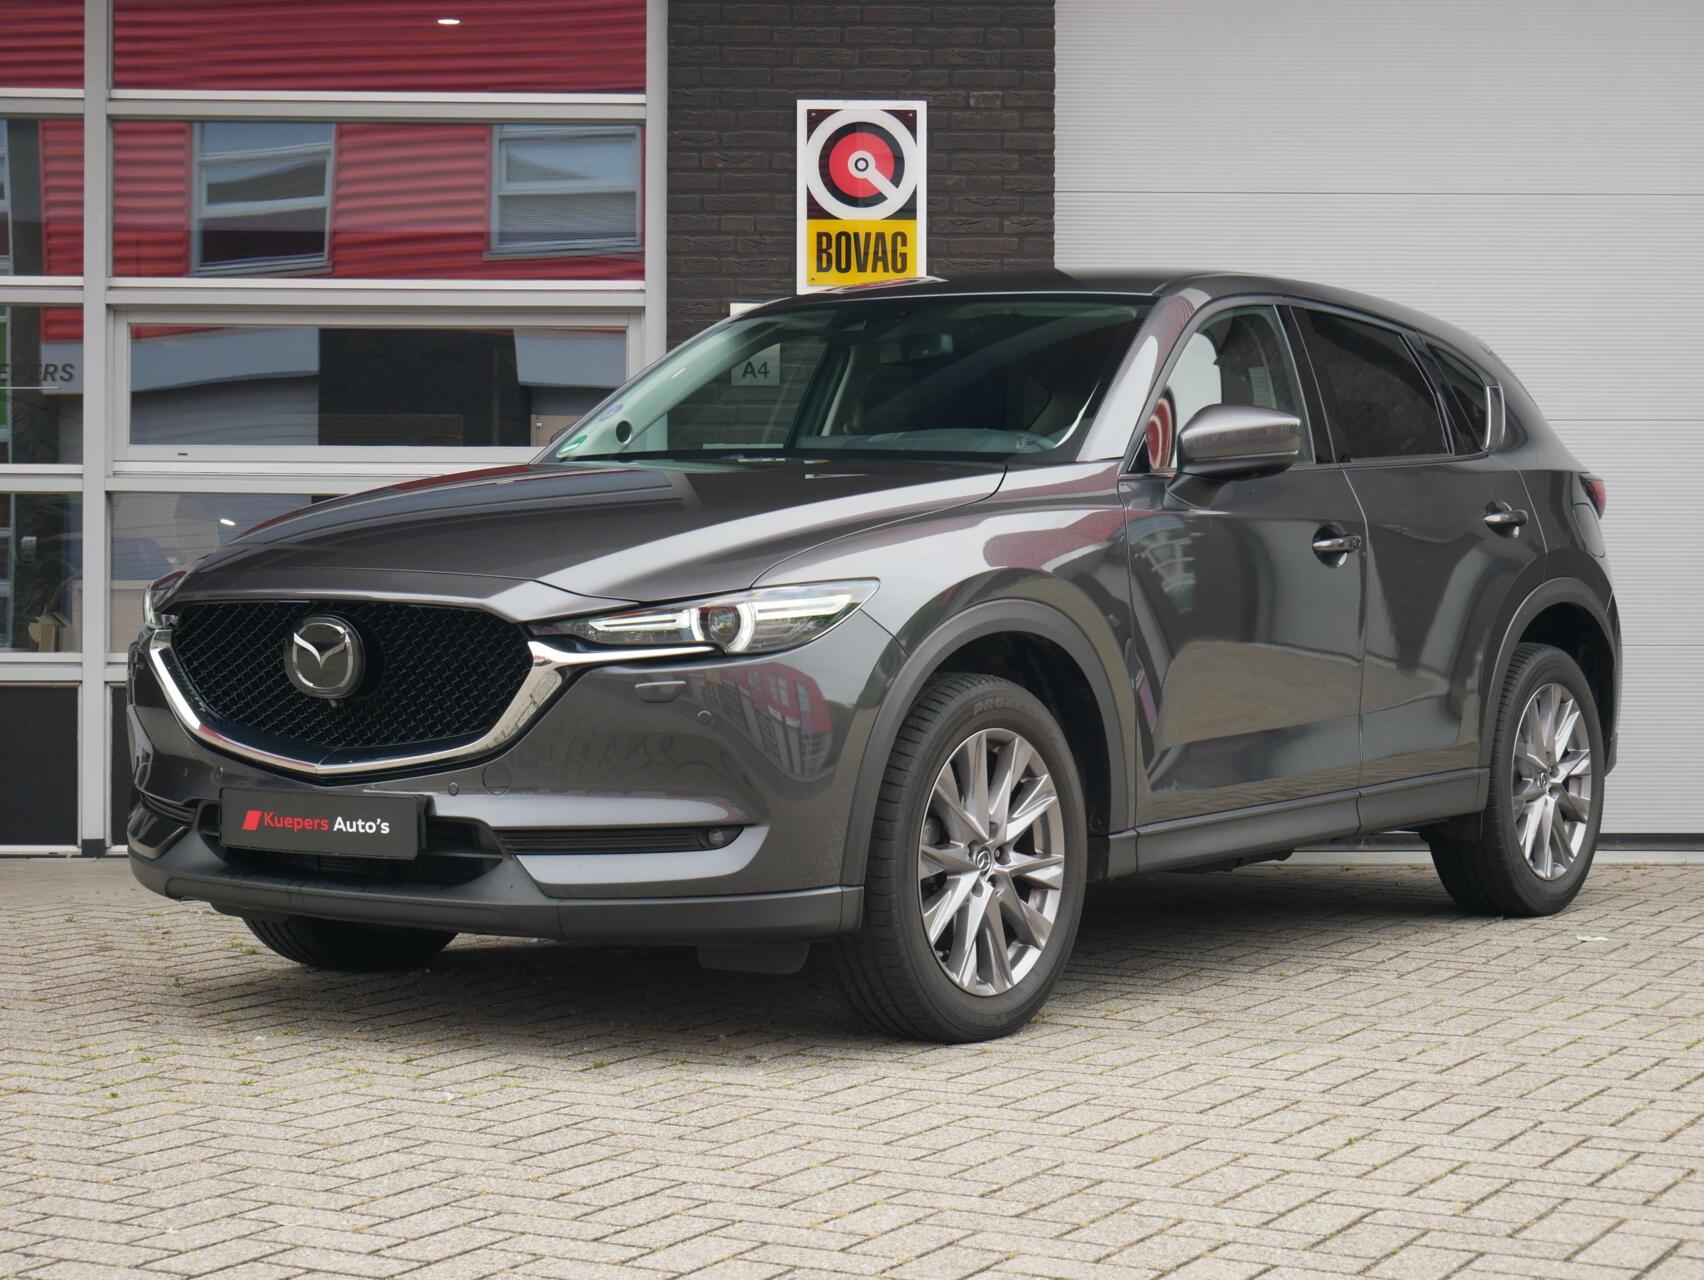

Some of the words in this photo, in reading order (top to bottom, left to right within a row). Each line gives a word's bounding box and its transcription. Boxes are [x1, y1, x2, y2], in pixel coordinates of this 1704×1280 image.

[816, 231, 908, 273] BOVAG
[742, 361, 769, 378] A4
[264, 812, 329, 832] Kuepers
